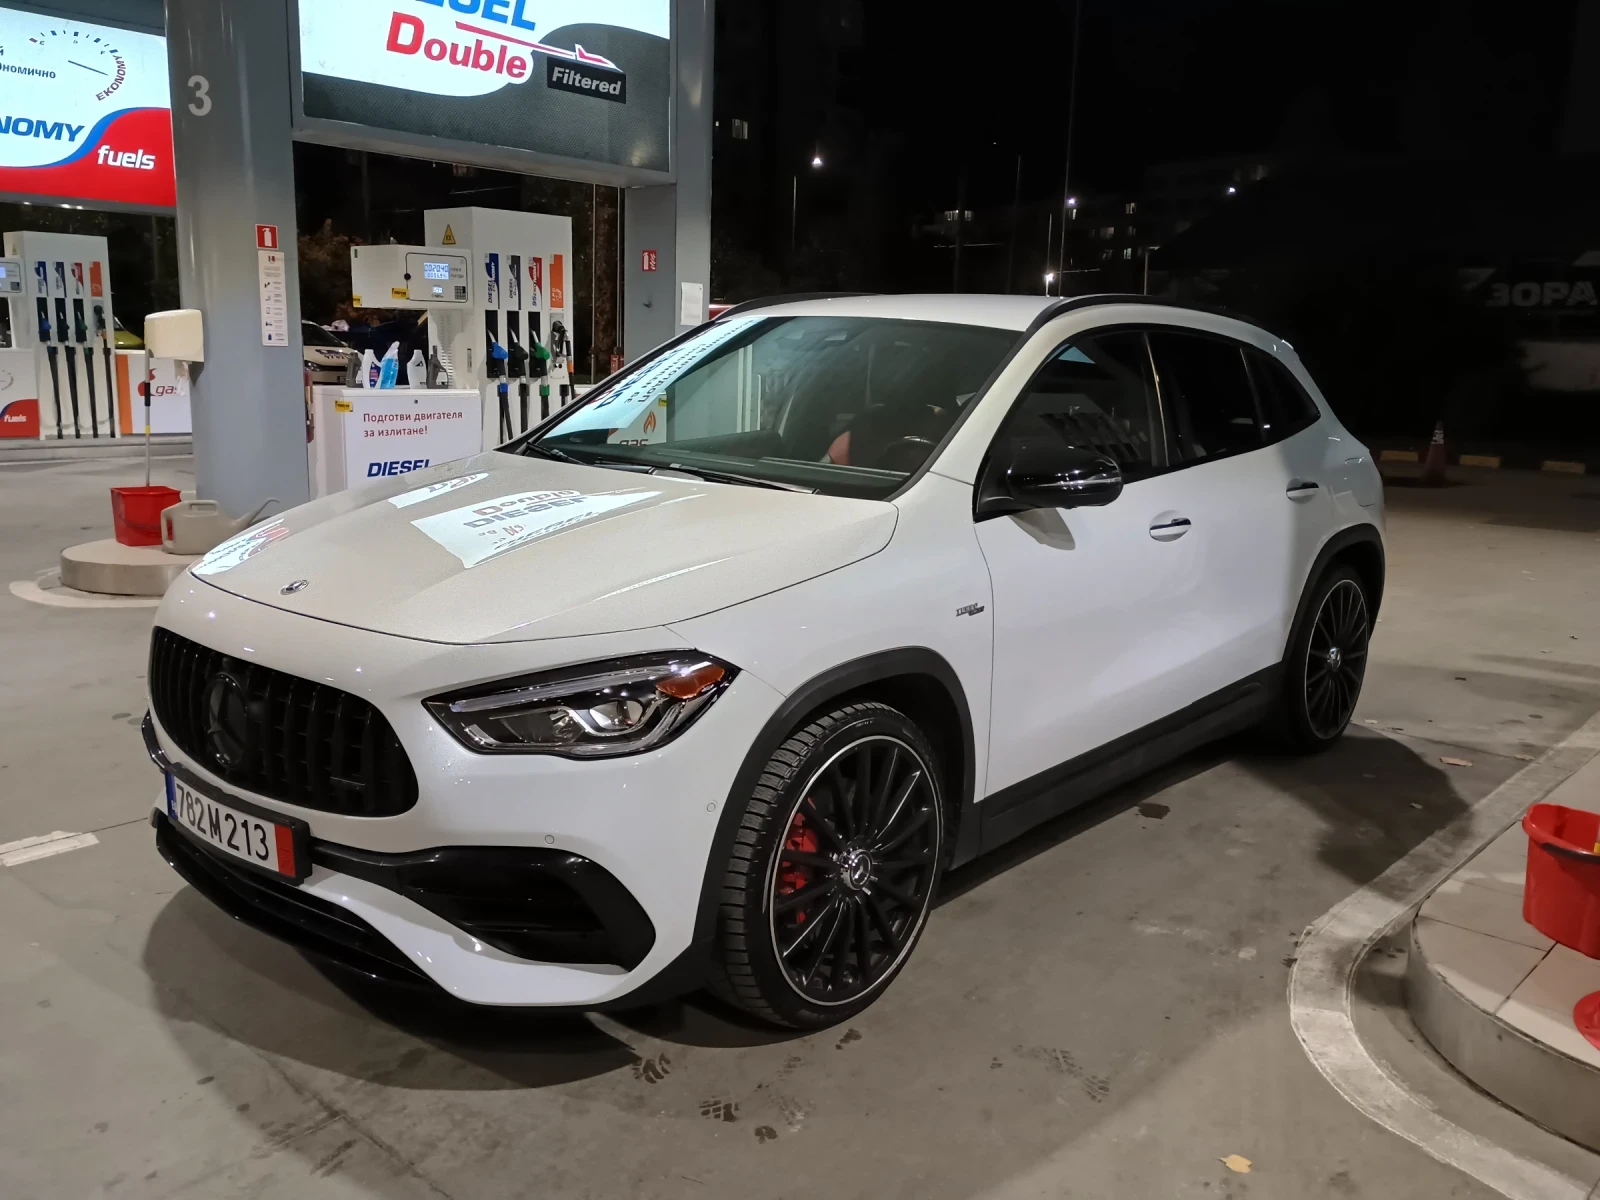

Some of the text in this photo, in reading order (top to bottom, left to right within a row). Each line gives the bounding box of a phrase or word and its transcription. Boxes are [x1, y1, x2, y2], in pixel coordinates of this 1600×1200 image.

[387, 12, 527, 79] Double
[0, 62, 56, 79] номично
[95, 54, 126, 101] EKONOMY
[551, 66, 622, 96] Filtered
[187, 75, 212, 117] 3
[97, 145, 155, 170] fuels
[1486, 281, 1598, 307] ЗОРА
[363, 411, 463, 424] Подготви двигателя
[363, 425, 428, 438] за излитане!
[176, 783, 270, 862] 782M213
